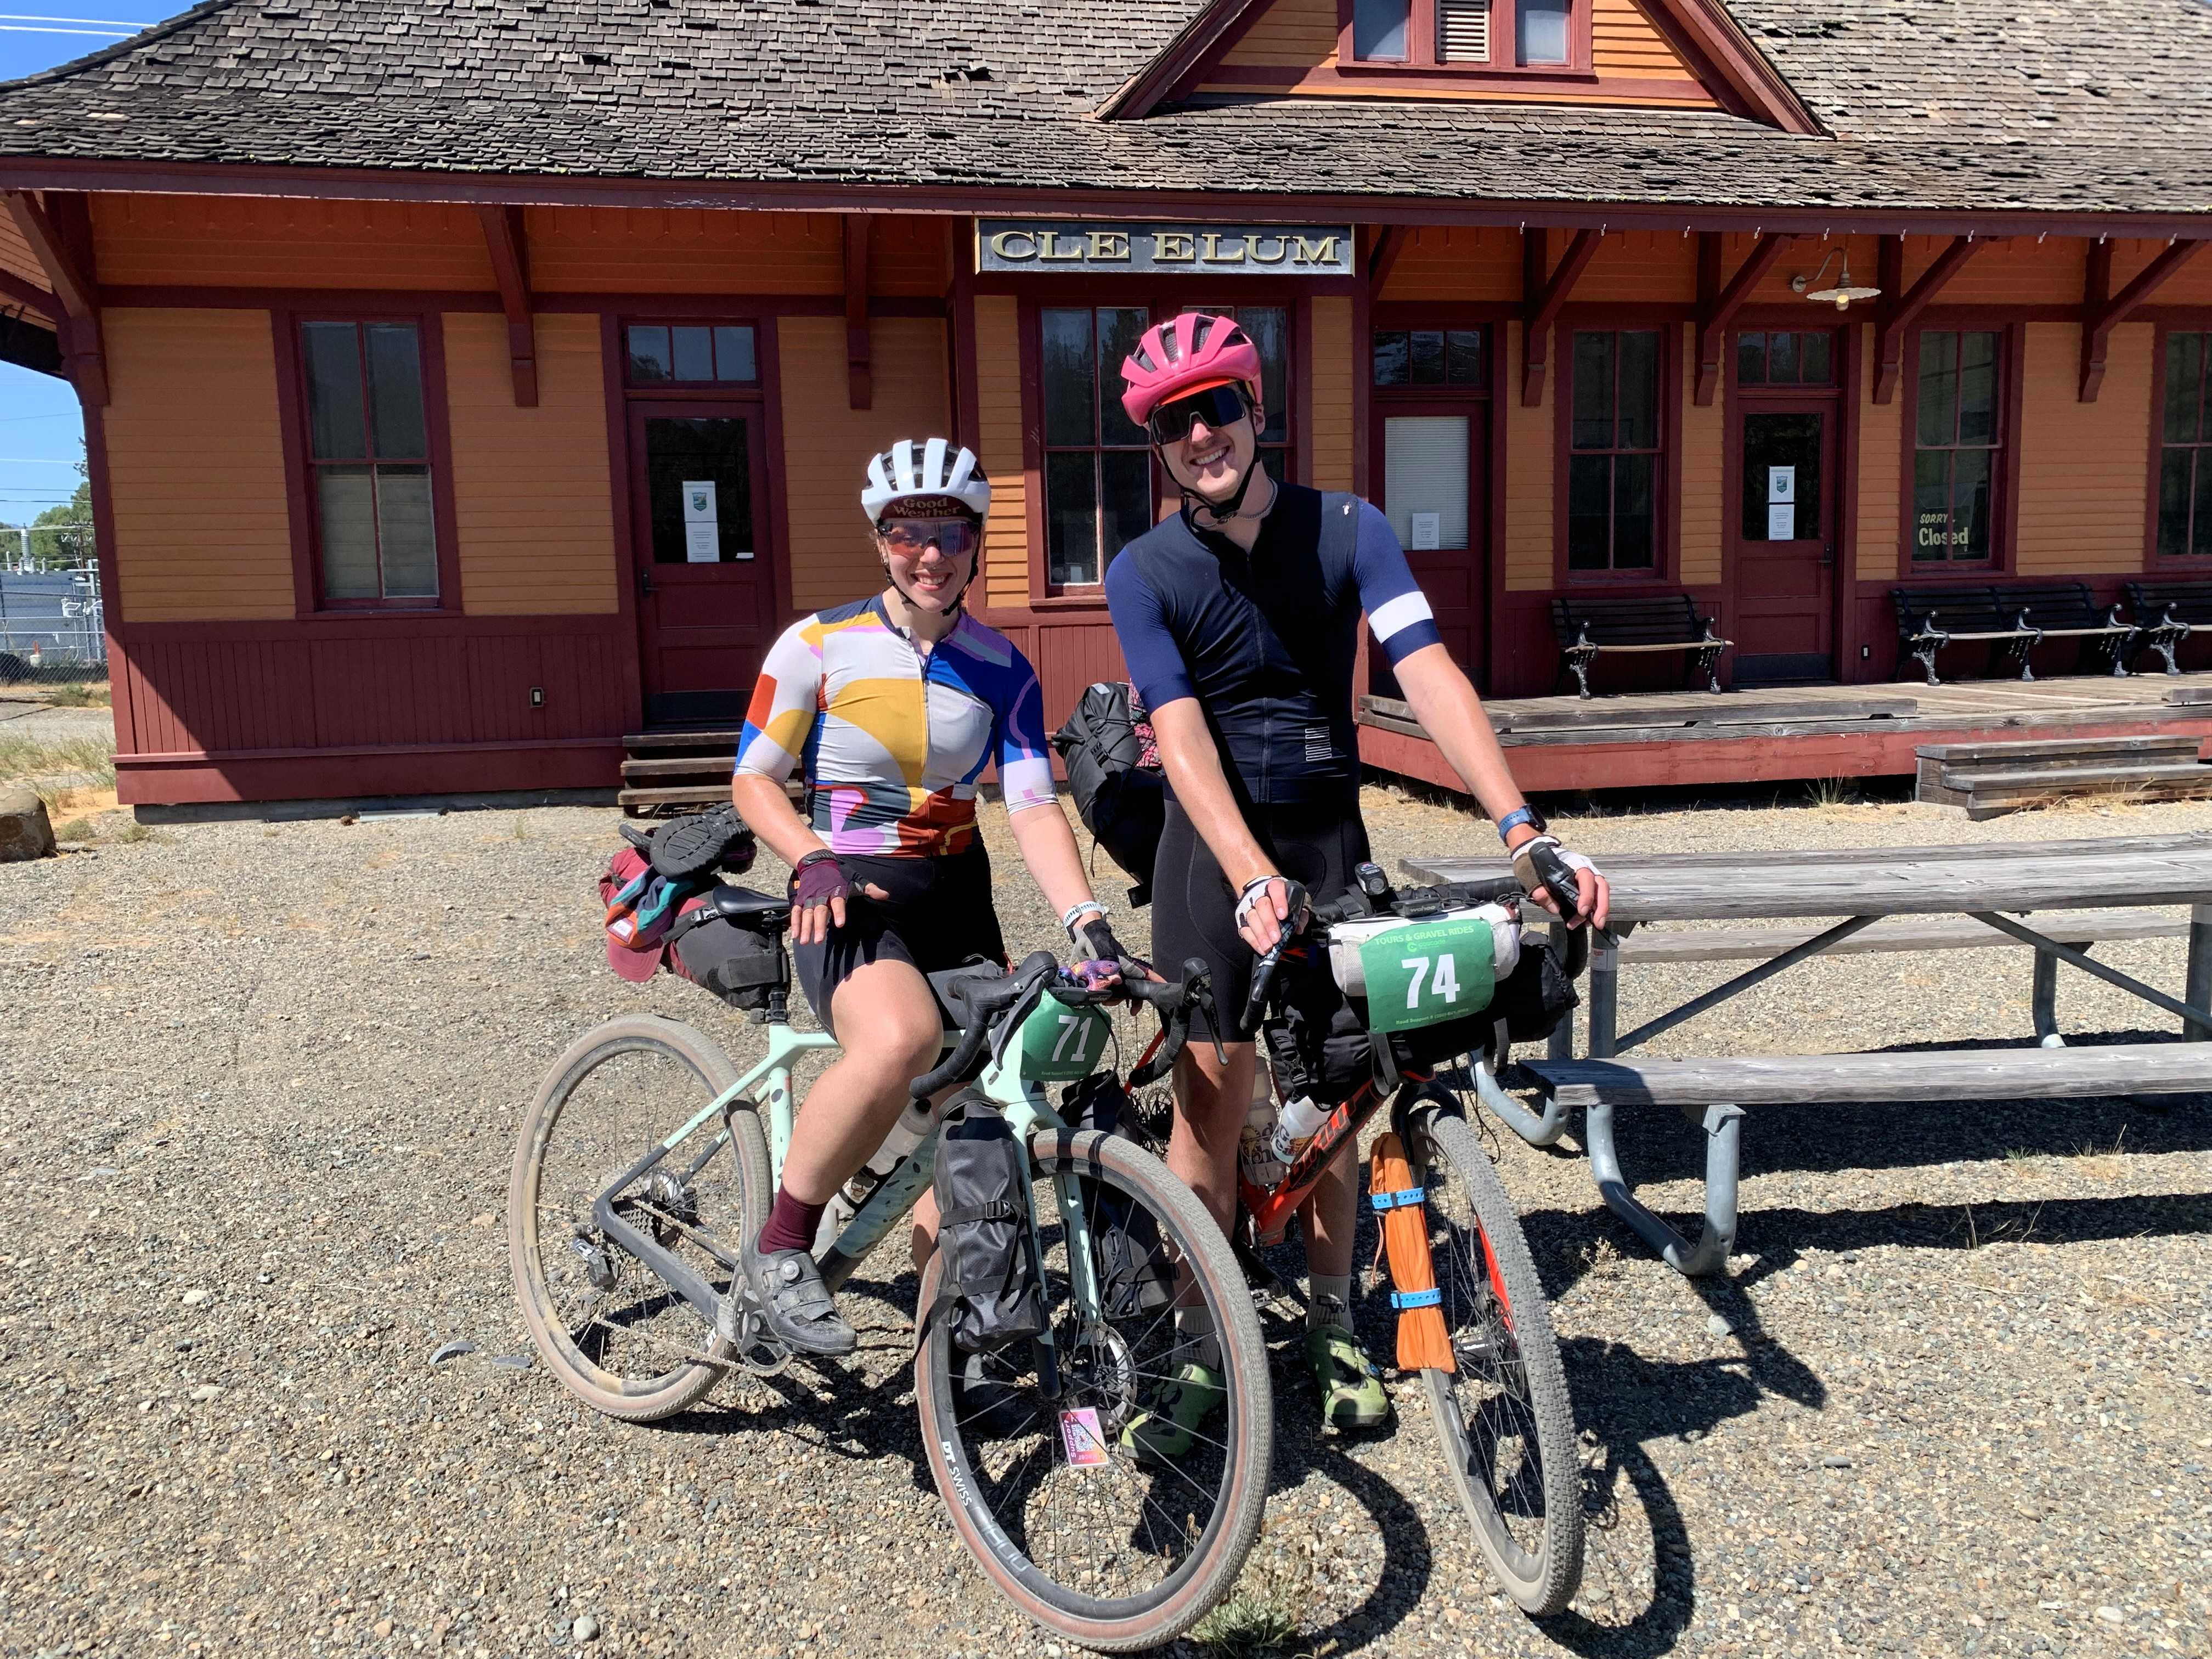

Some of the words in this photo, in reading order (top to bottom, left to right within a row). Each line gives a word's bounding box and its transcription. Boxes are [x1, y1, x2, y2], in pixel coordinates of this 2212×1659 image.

[991, 231, 1130, 261] CLE
[1151, 233, 1341, 262] ELUM
[893, 504, 960, 517] Weather
[903, 496, 948, 509] Good
[1919, 527, 1969, 546] Closed
[1374, 935, 1404, 945] TOURS
[1413, 929, 1448, 940] GRAVEL
[1448, 926, 1474, 936] RIDES
[1401, 953, 1460, 1009] 74
[1052, 1015, 1092, 1062] 71
[942, 1441, 956, 1463] DT
[950, 1466, 972, 1506] SWISS
